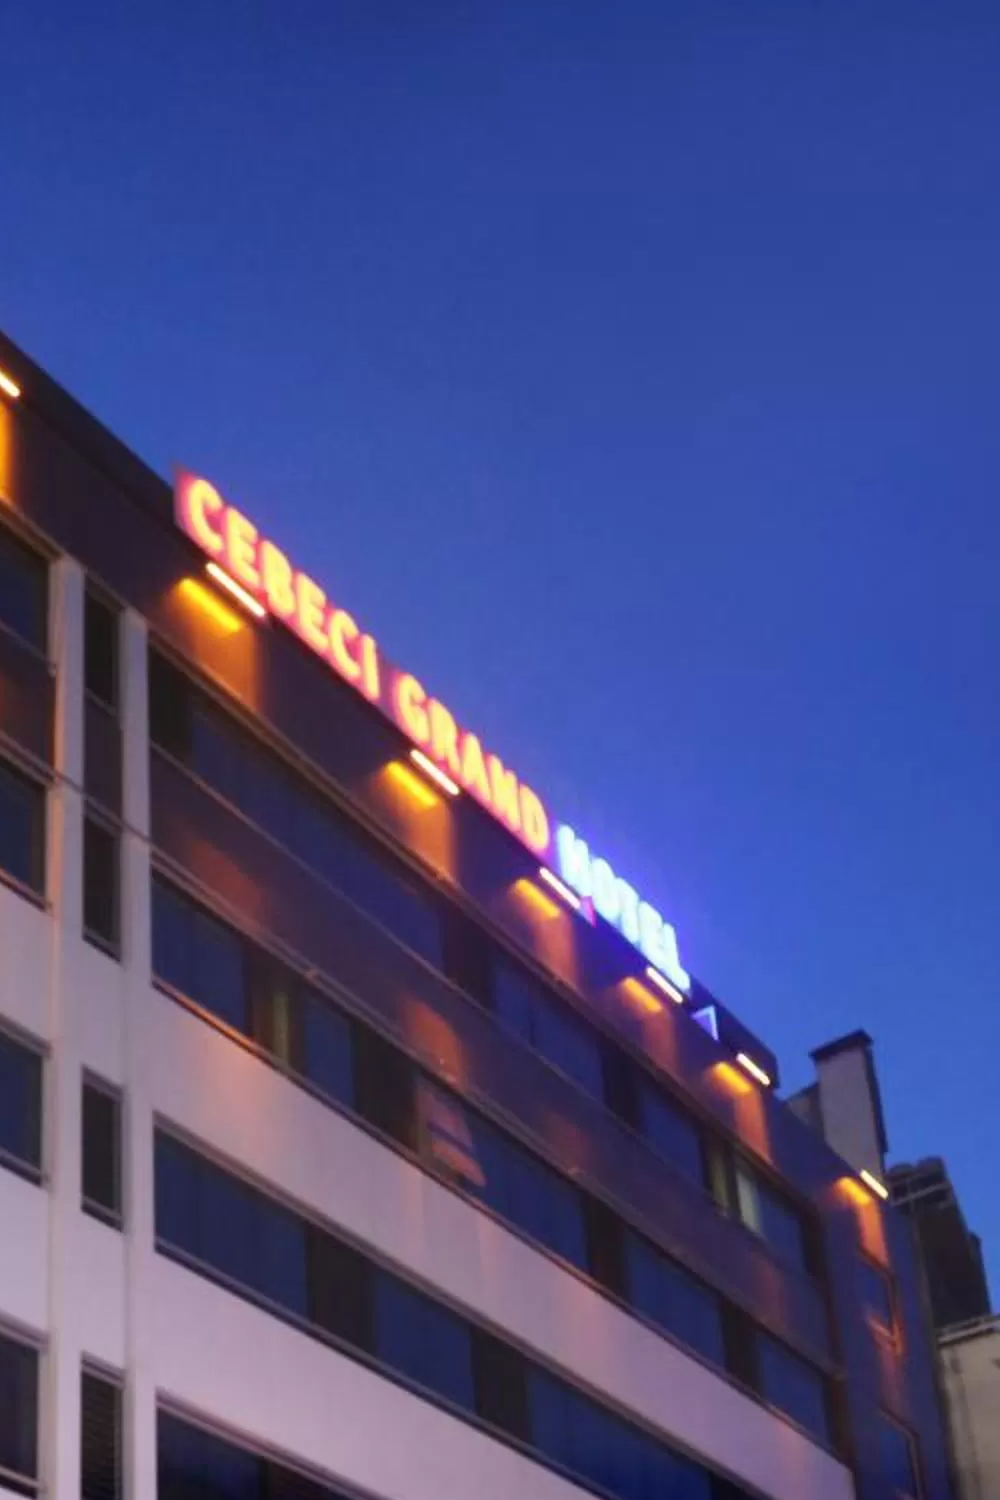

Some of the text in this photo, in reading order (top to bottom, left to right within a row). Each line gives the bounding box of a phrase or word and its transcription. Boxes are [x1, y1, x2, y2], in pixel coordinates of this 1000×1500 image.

[181, 475, 691, 992] CEBECI GRAND HOTEL
